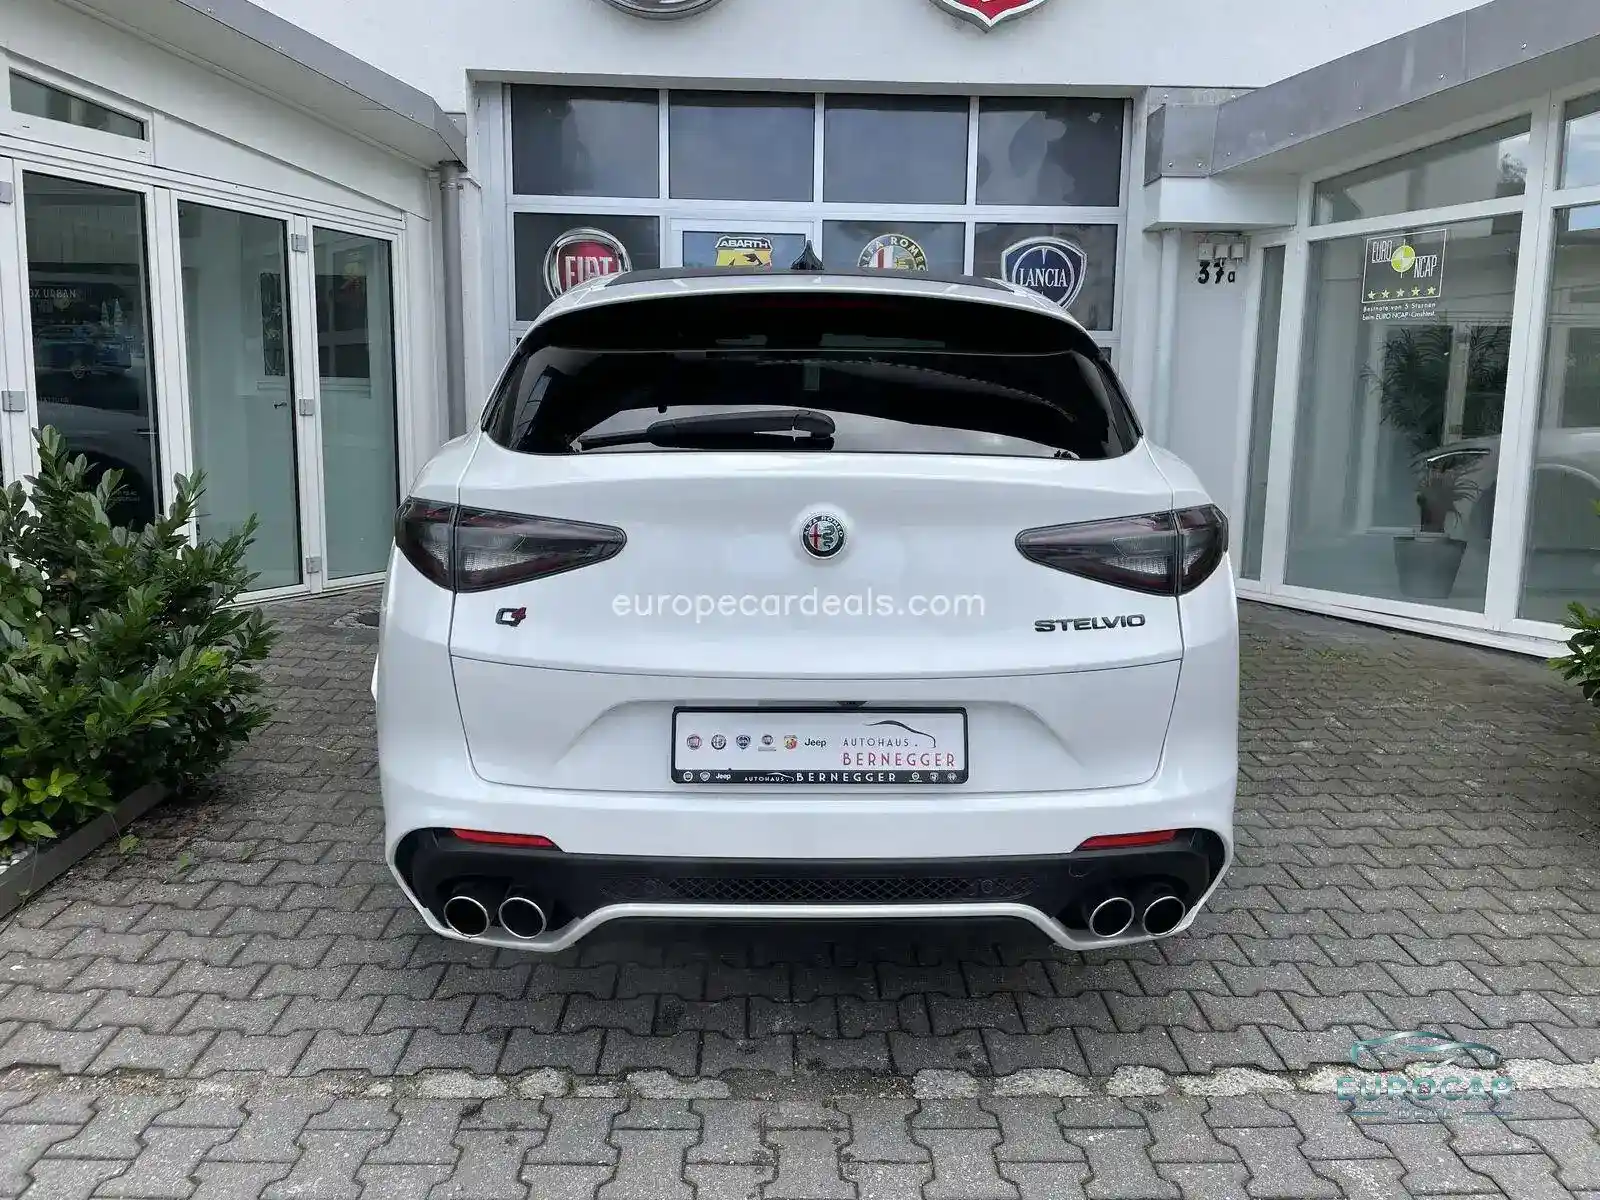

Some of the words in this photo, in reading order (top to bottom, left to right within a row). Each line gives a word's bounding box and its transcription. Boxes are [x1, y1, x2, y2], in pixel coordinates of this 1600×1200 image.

[720, 239, 768, 248] ABARTH
[1372, 240, 1393, 262] EURO
[565, 255, 612, 290] FIAT
[1414, 255, 1438, 278] NCAP
[1019, 268, 1068, 288] LANCIA
[43, 288, 77, 298] URBAN
[1034, 613, 1146, 632] STELVIO
[804, 738, 827, 748] Jeep
[843, 738, 909, 747] AUTOHAUS
[843, 752, 955, 766] BERNEGGER
[715, 773, 731, 781] Jeep
[796, 772, 896, 782] BERNEGGER
